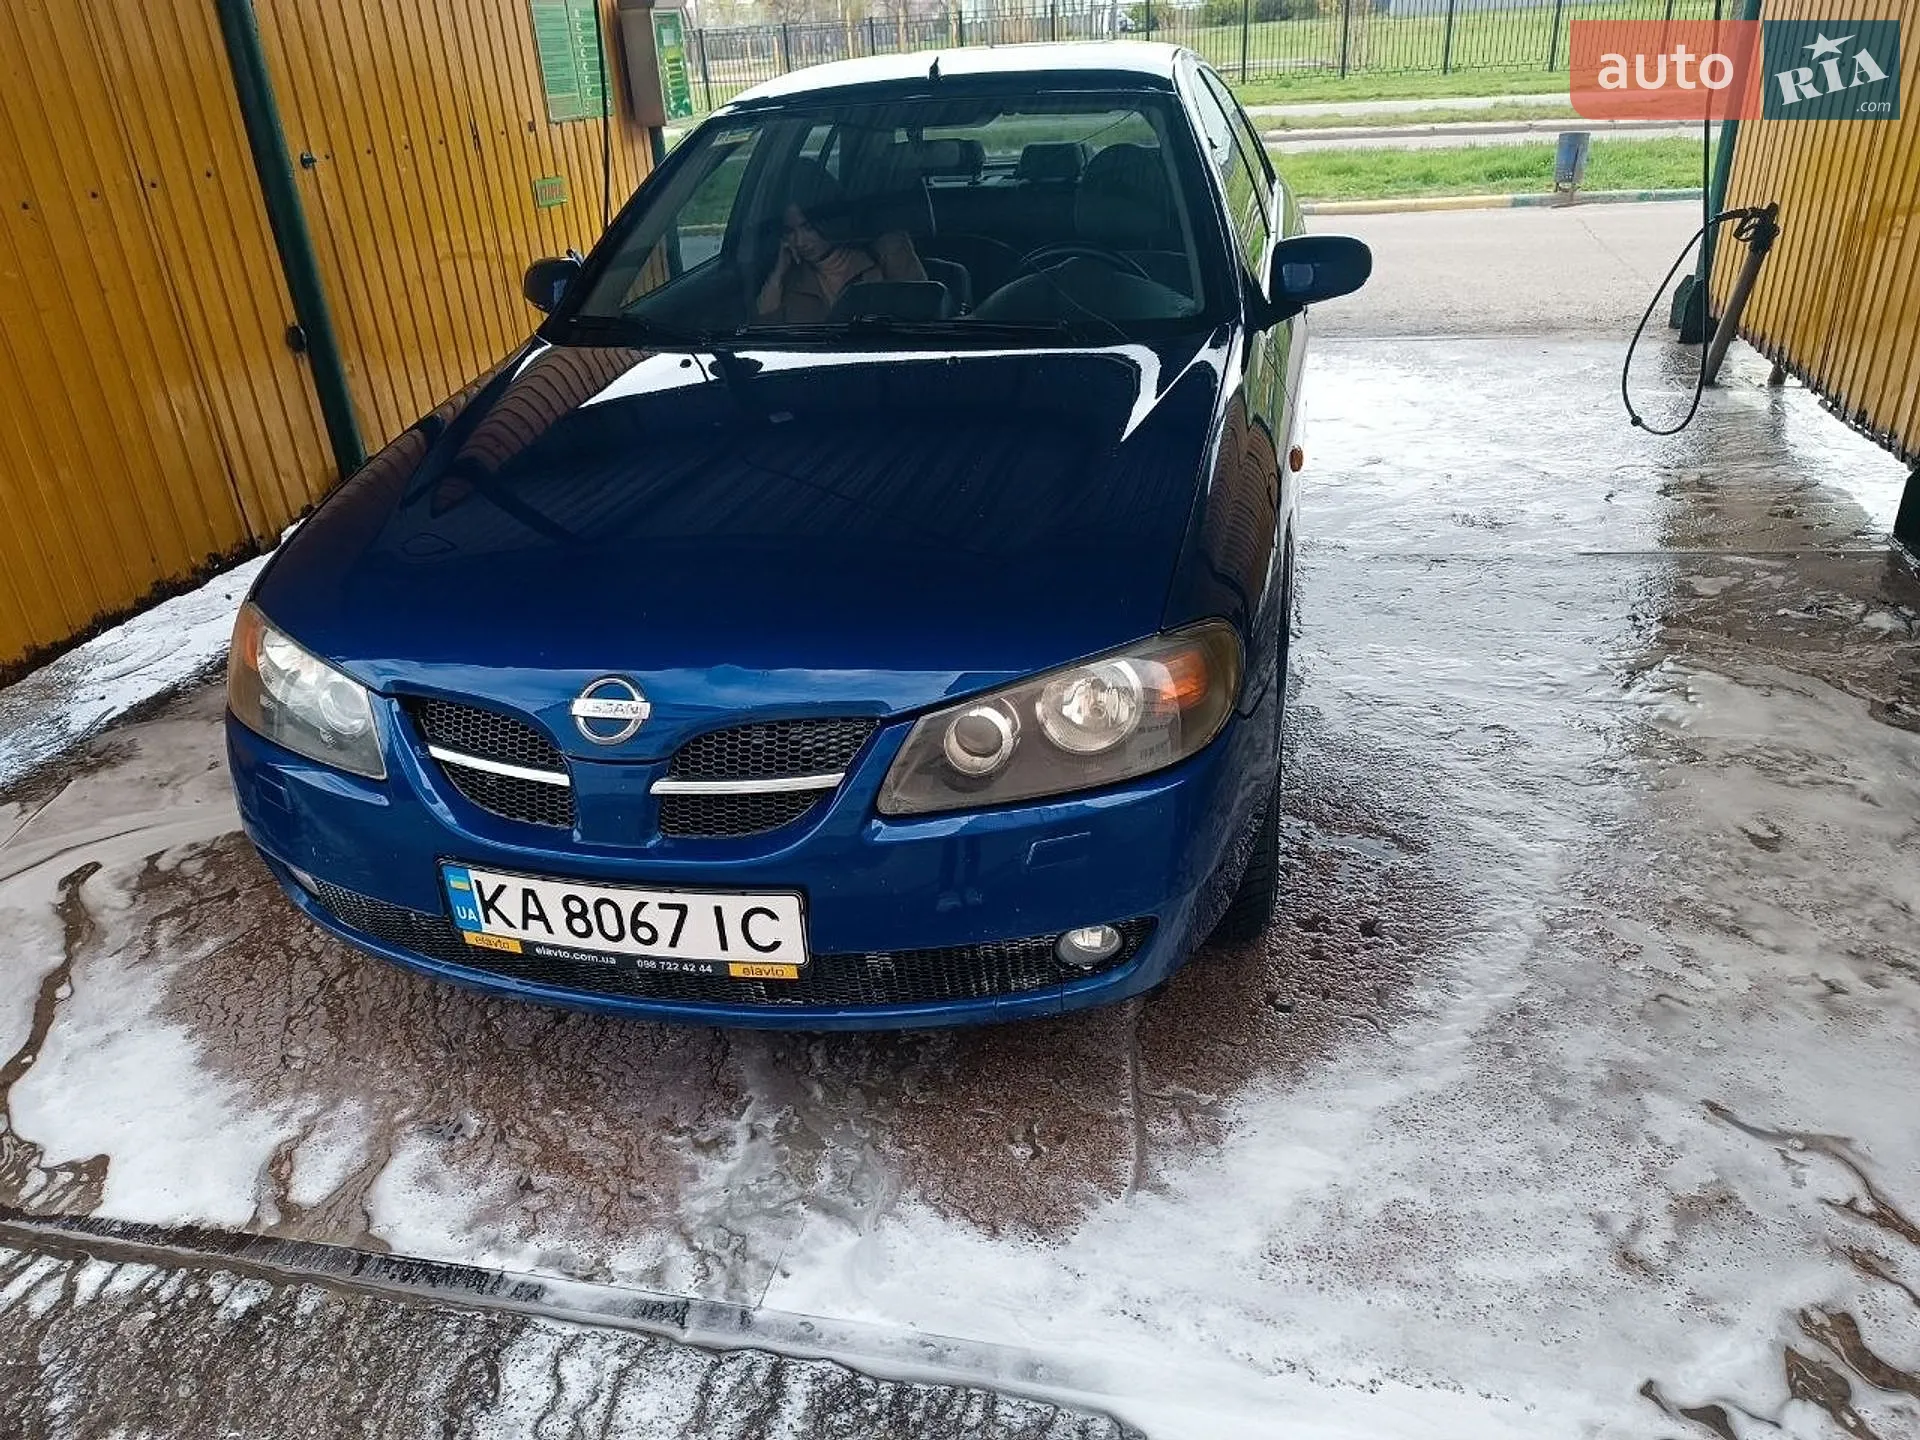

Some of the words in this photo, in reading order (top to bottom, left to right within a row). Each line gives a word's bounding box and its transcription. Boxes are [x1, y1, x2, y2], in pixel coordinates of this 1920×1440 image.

[577, 702, 640, 715] ISSAN
[457, 906, 478, 922] UA
[475, 879, 555, 935] KA
[562, 894, 689, 948] 8067
[713, 905, 783, 953] IC
[535, 945, 616, 965] elavto.com.ua
[636, 959, 657, 969] 098
[659, 961, 680, 971] 722
[682, 962, 696, 972] 42
[699, 964, 712, 974] 44
